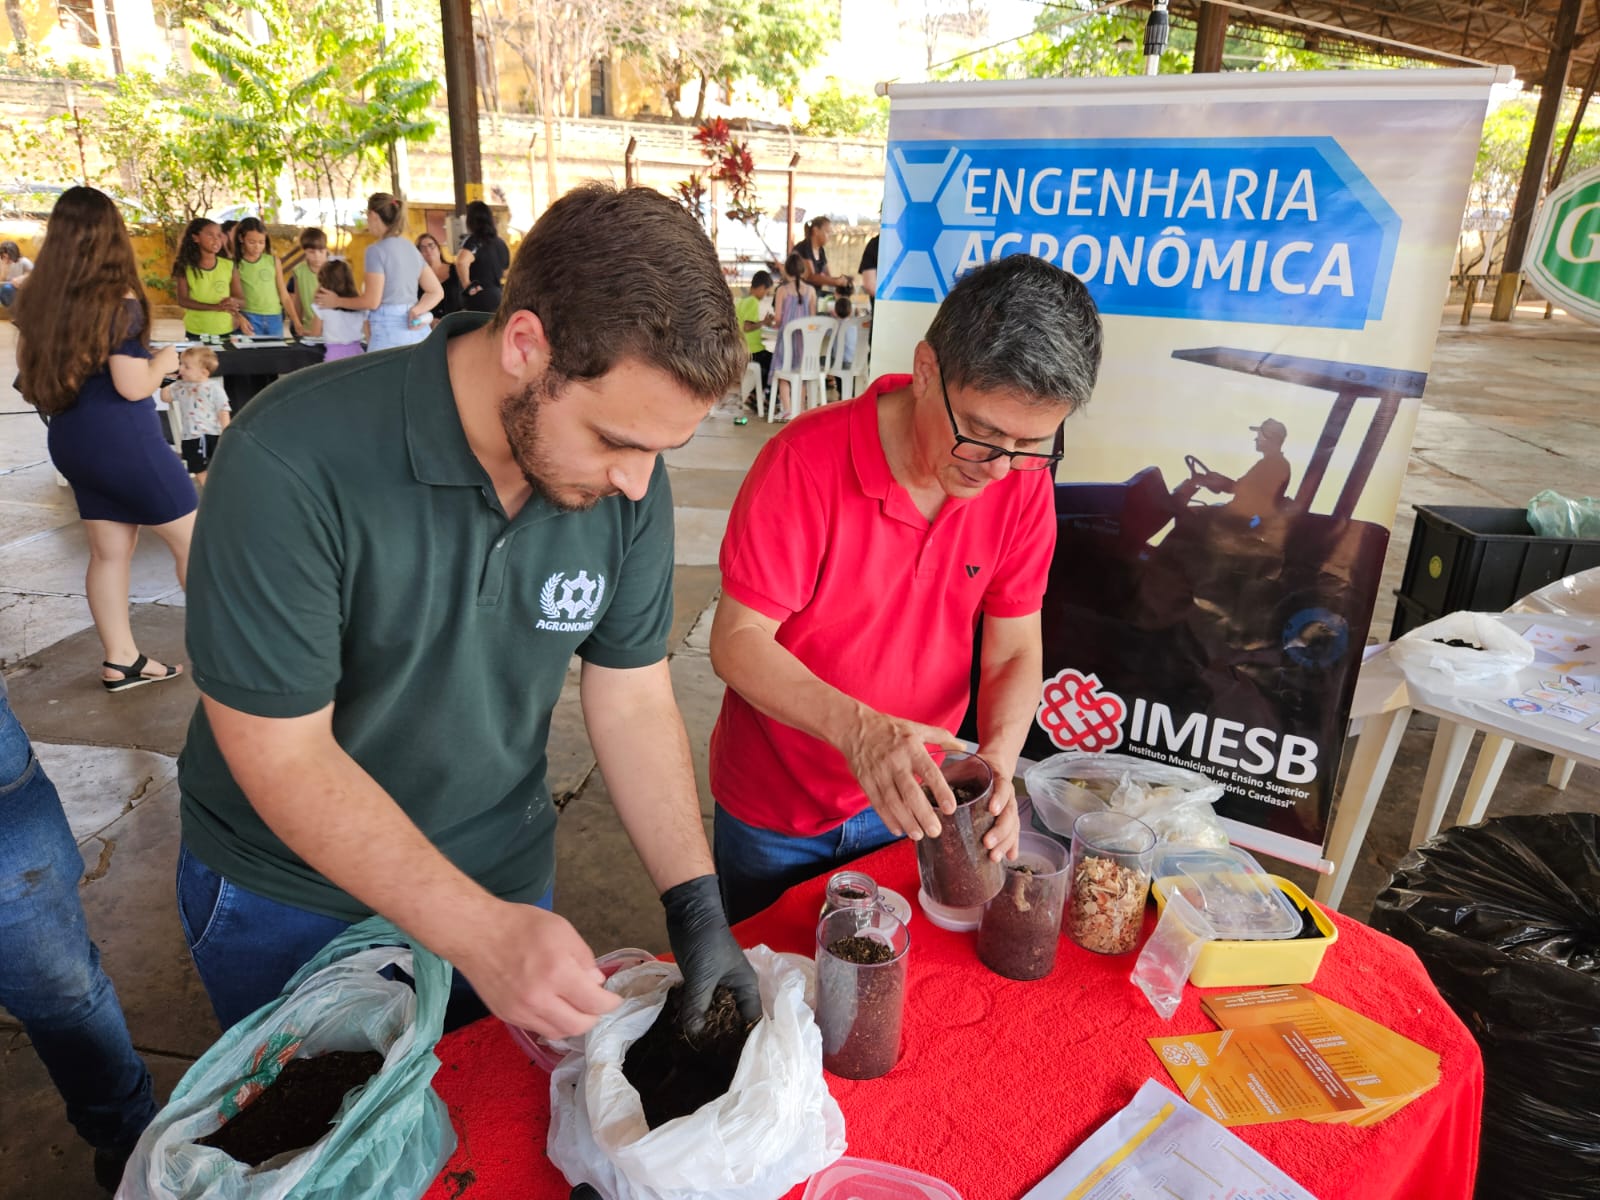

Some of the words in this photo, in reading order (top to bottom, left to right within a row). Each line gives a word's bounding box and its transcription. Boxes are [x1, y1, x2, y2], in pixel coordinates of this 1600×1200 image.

[963, 167, 1318, 222] ENGENHARIA
[1129, 697, 1319, 785] IMESB
[1128, 743, 1167, 761] Instituto
[1168, 754, 1215, 775] Municipal
[1216, 768, 1230, 779] de
[1231, 771, 1264, 788] Ensino
[1265, 781, 1310, 799] Superior
